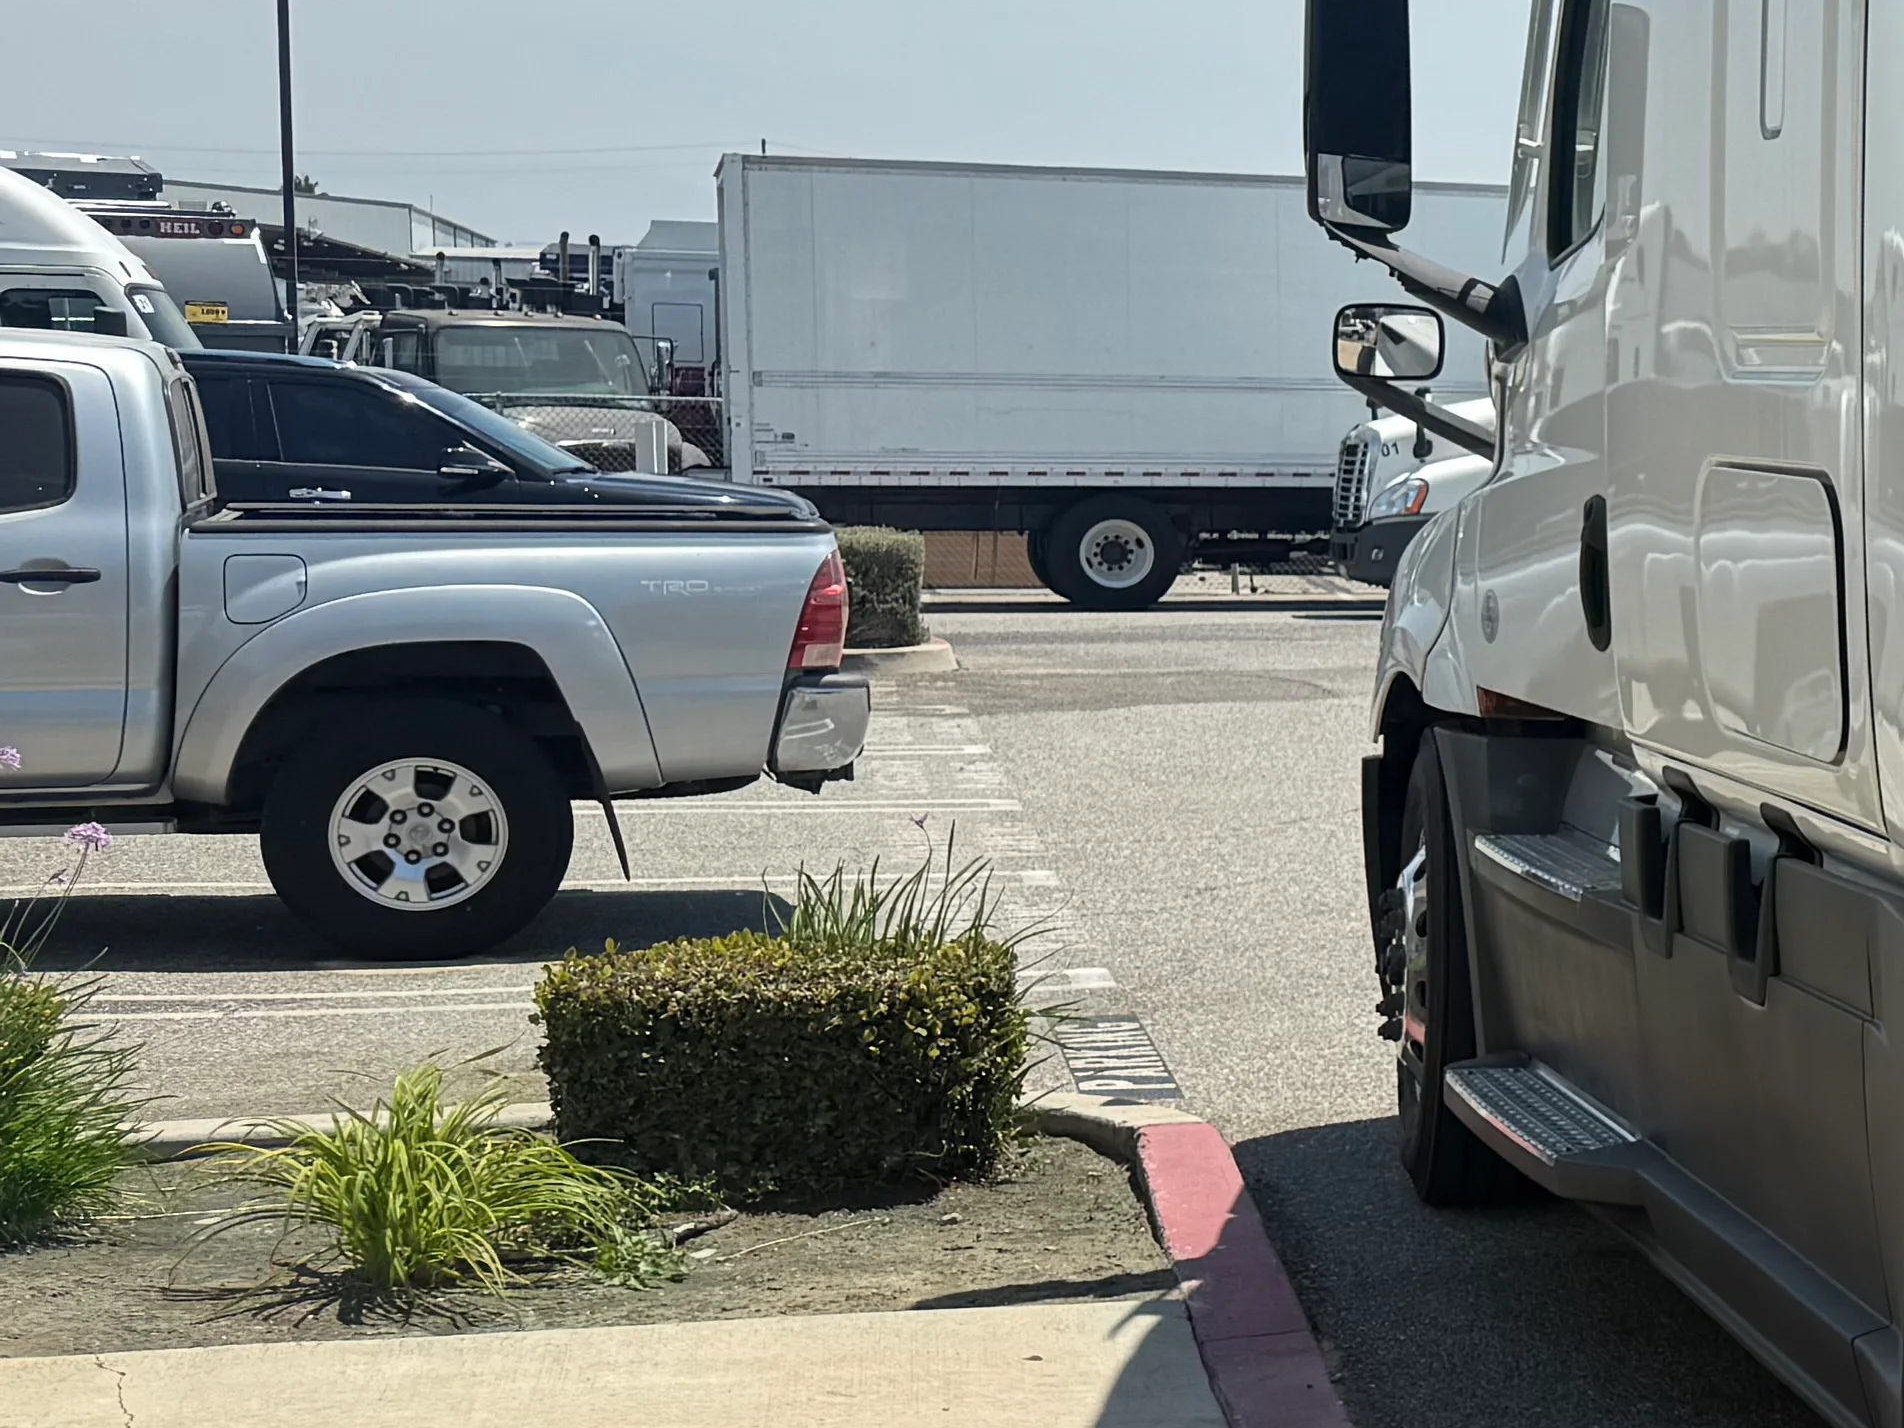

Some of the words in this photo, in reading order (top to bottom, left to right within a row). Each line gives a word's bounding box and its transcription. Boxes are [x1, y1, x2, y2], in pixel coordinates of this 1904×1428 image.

[159, 221, 200, 234] HEIL
[1381, 441, 1399, 457] 01
[640, 580, 709, 596] TRD
